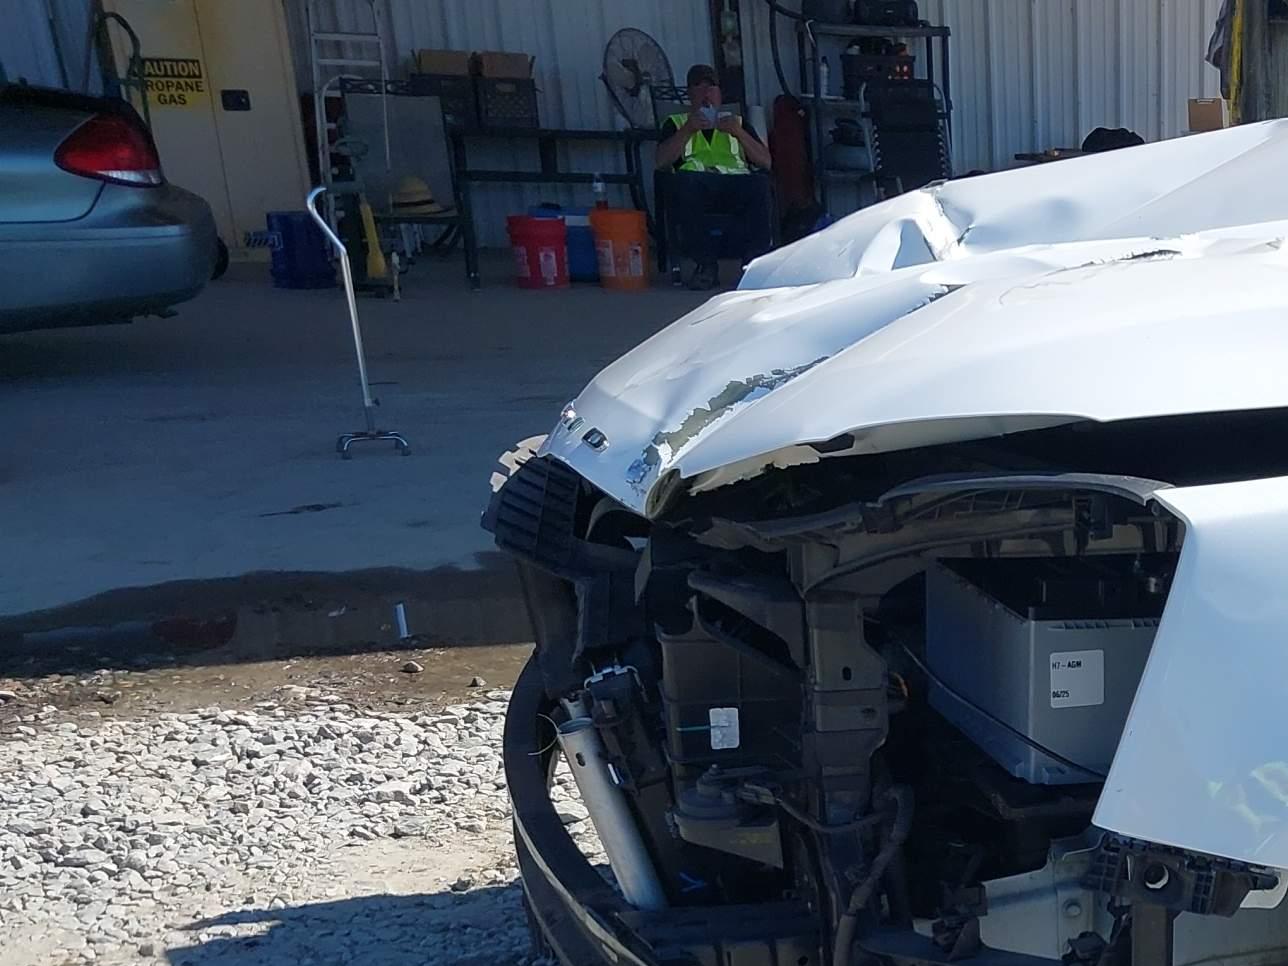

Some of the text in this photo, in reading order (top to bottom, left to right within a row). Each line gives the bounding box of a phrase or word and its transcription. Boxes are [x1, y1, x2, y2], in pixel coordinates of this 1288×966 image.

[144, 60, 201, 77] AUTION
[145, 79, 205, 92] ROPANE
[157, 93, 187, 105] GAS
